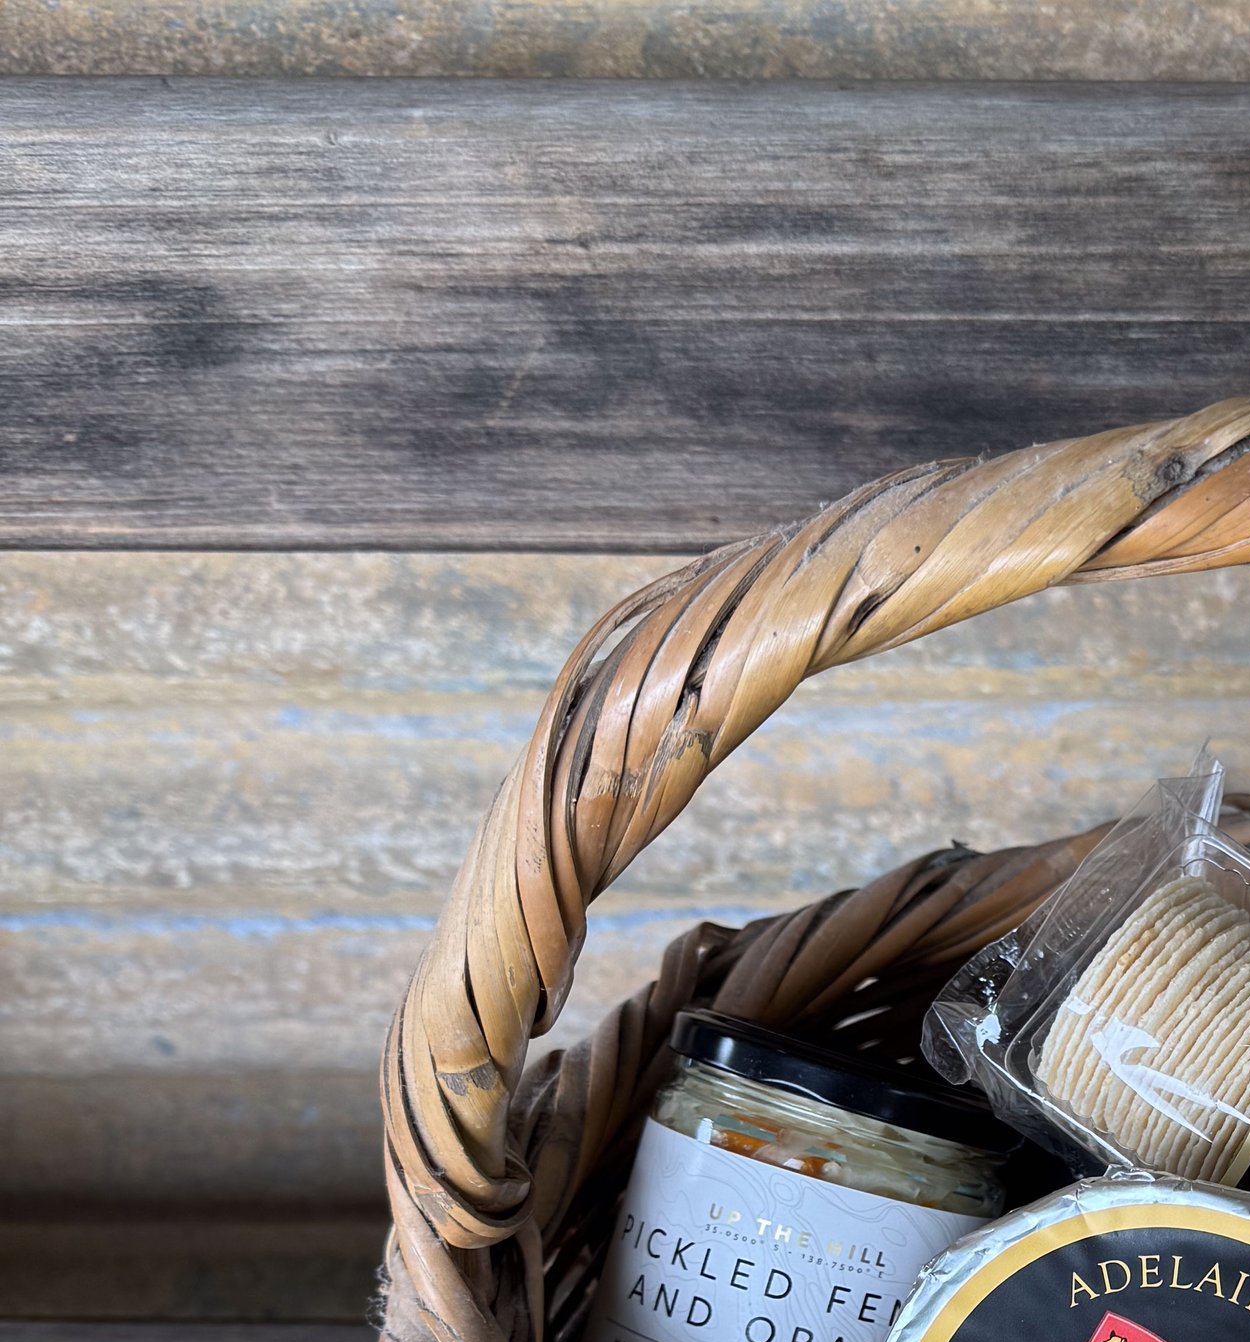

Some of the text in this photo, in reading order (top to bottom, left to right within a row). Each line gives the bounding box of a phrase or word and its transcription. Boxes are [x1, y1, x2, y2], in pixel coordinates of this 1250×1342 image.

[621, 1213, 793, 1299] PICKLED
[708, 1202, 886, 1268] UP THE HILL
[628, 1274, 713, 1327] AND
